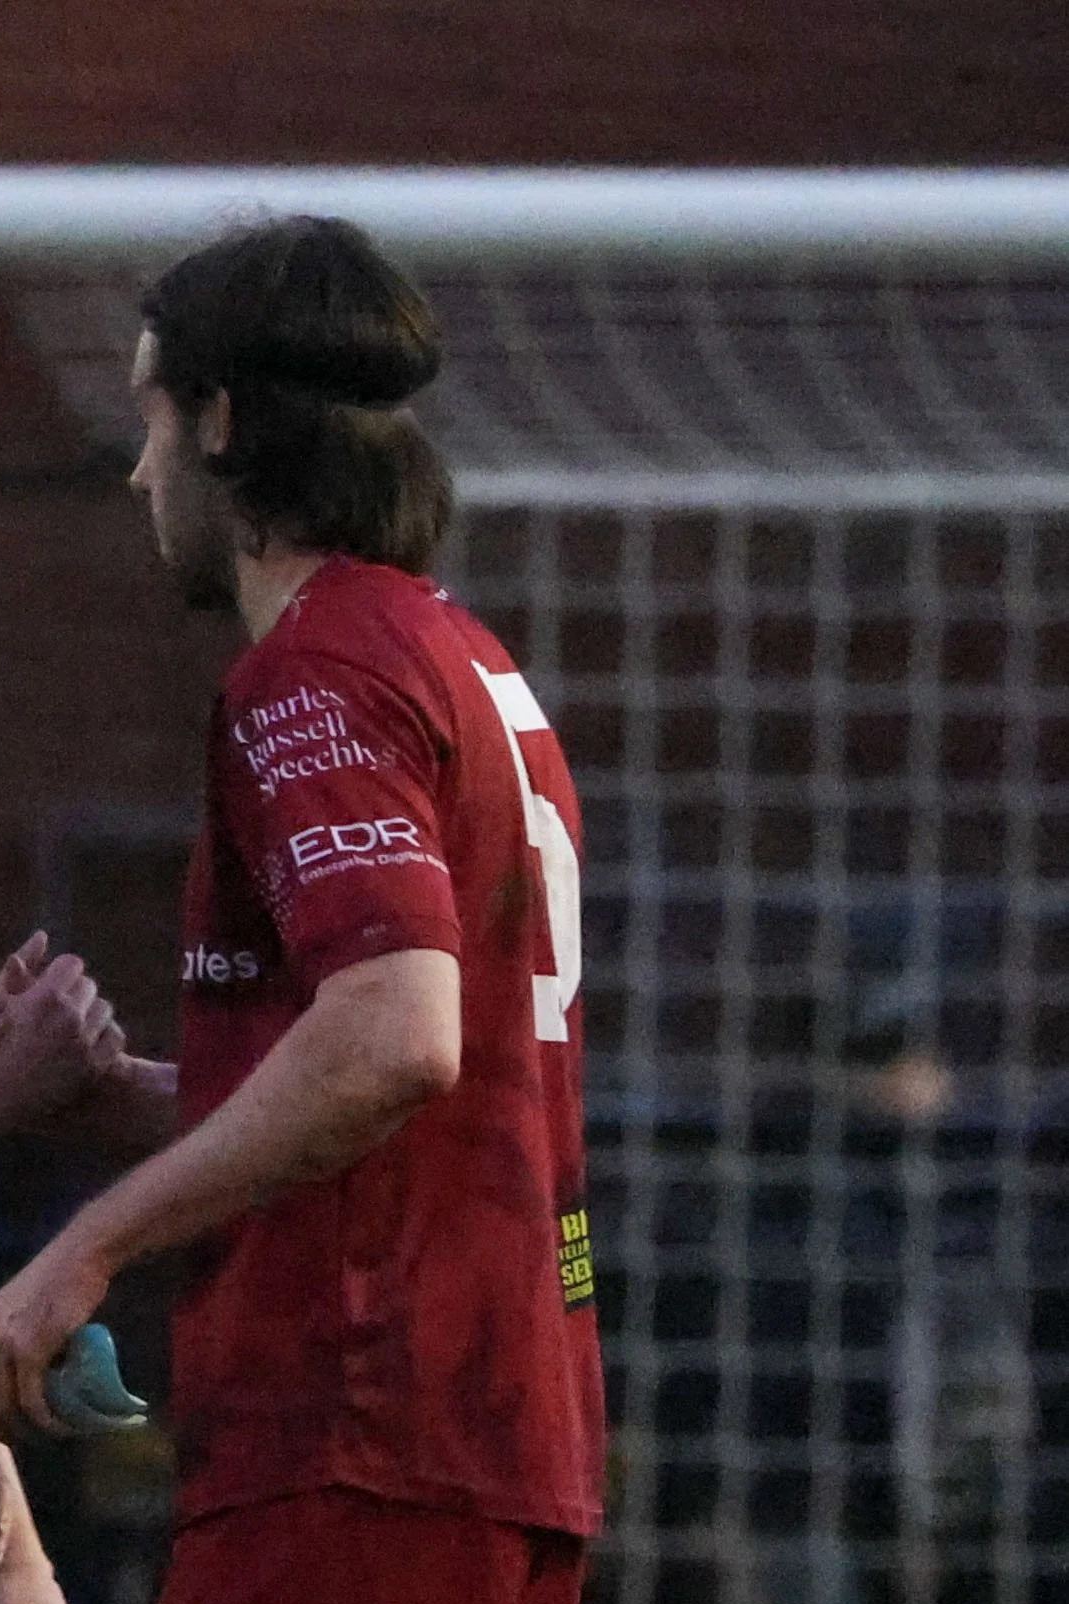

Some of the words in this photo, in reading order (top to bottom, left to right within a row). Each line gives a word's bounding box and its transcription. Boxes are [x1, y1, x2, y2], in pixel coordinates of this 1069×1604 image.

[233, 685, 346, 745] Charles
[246, 710, 347, 775] Russell
[289, 817, 421, 868] EDR
